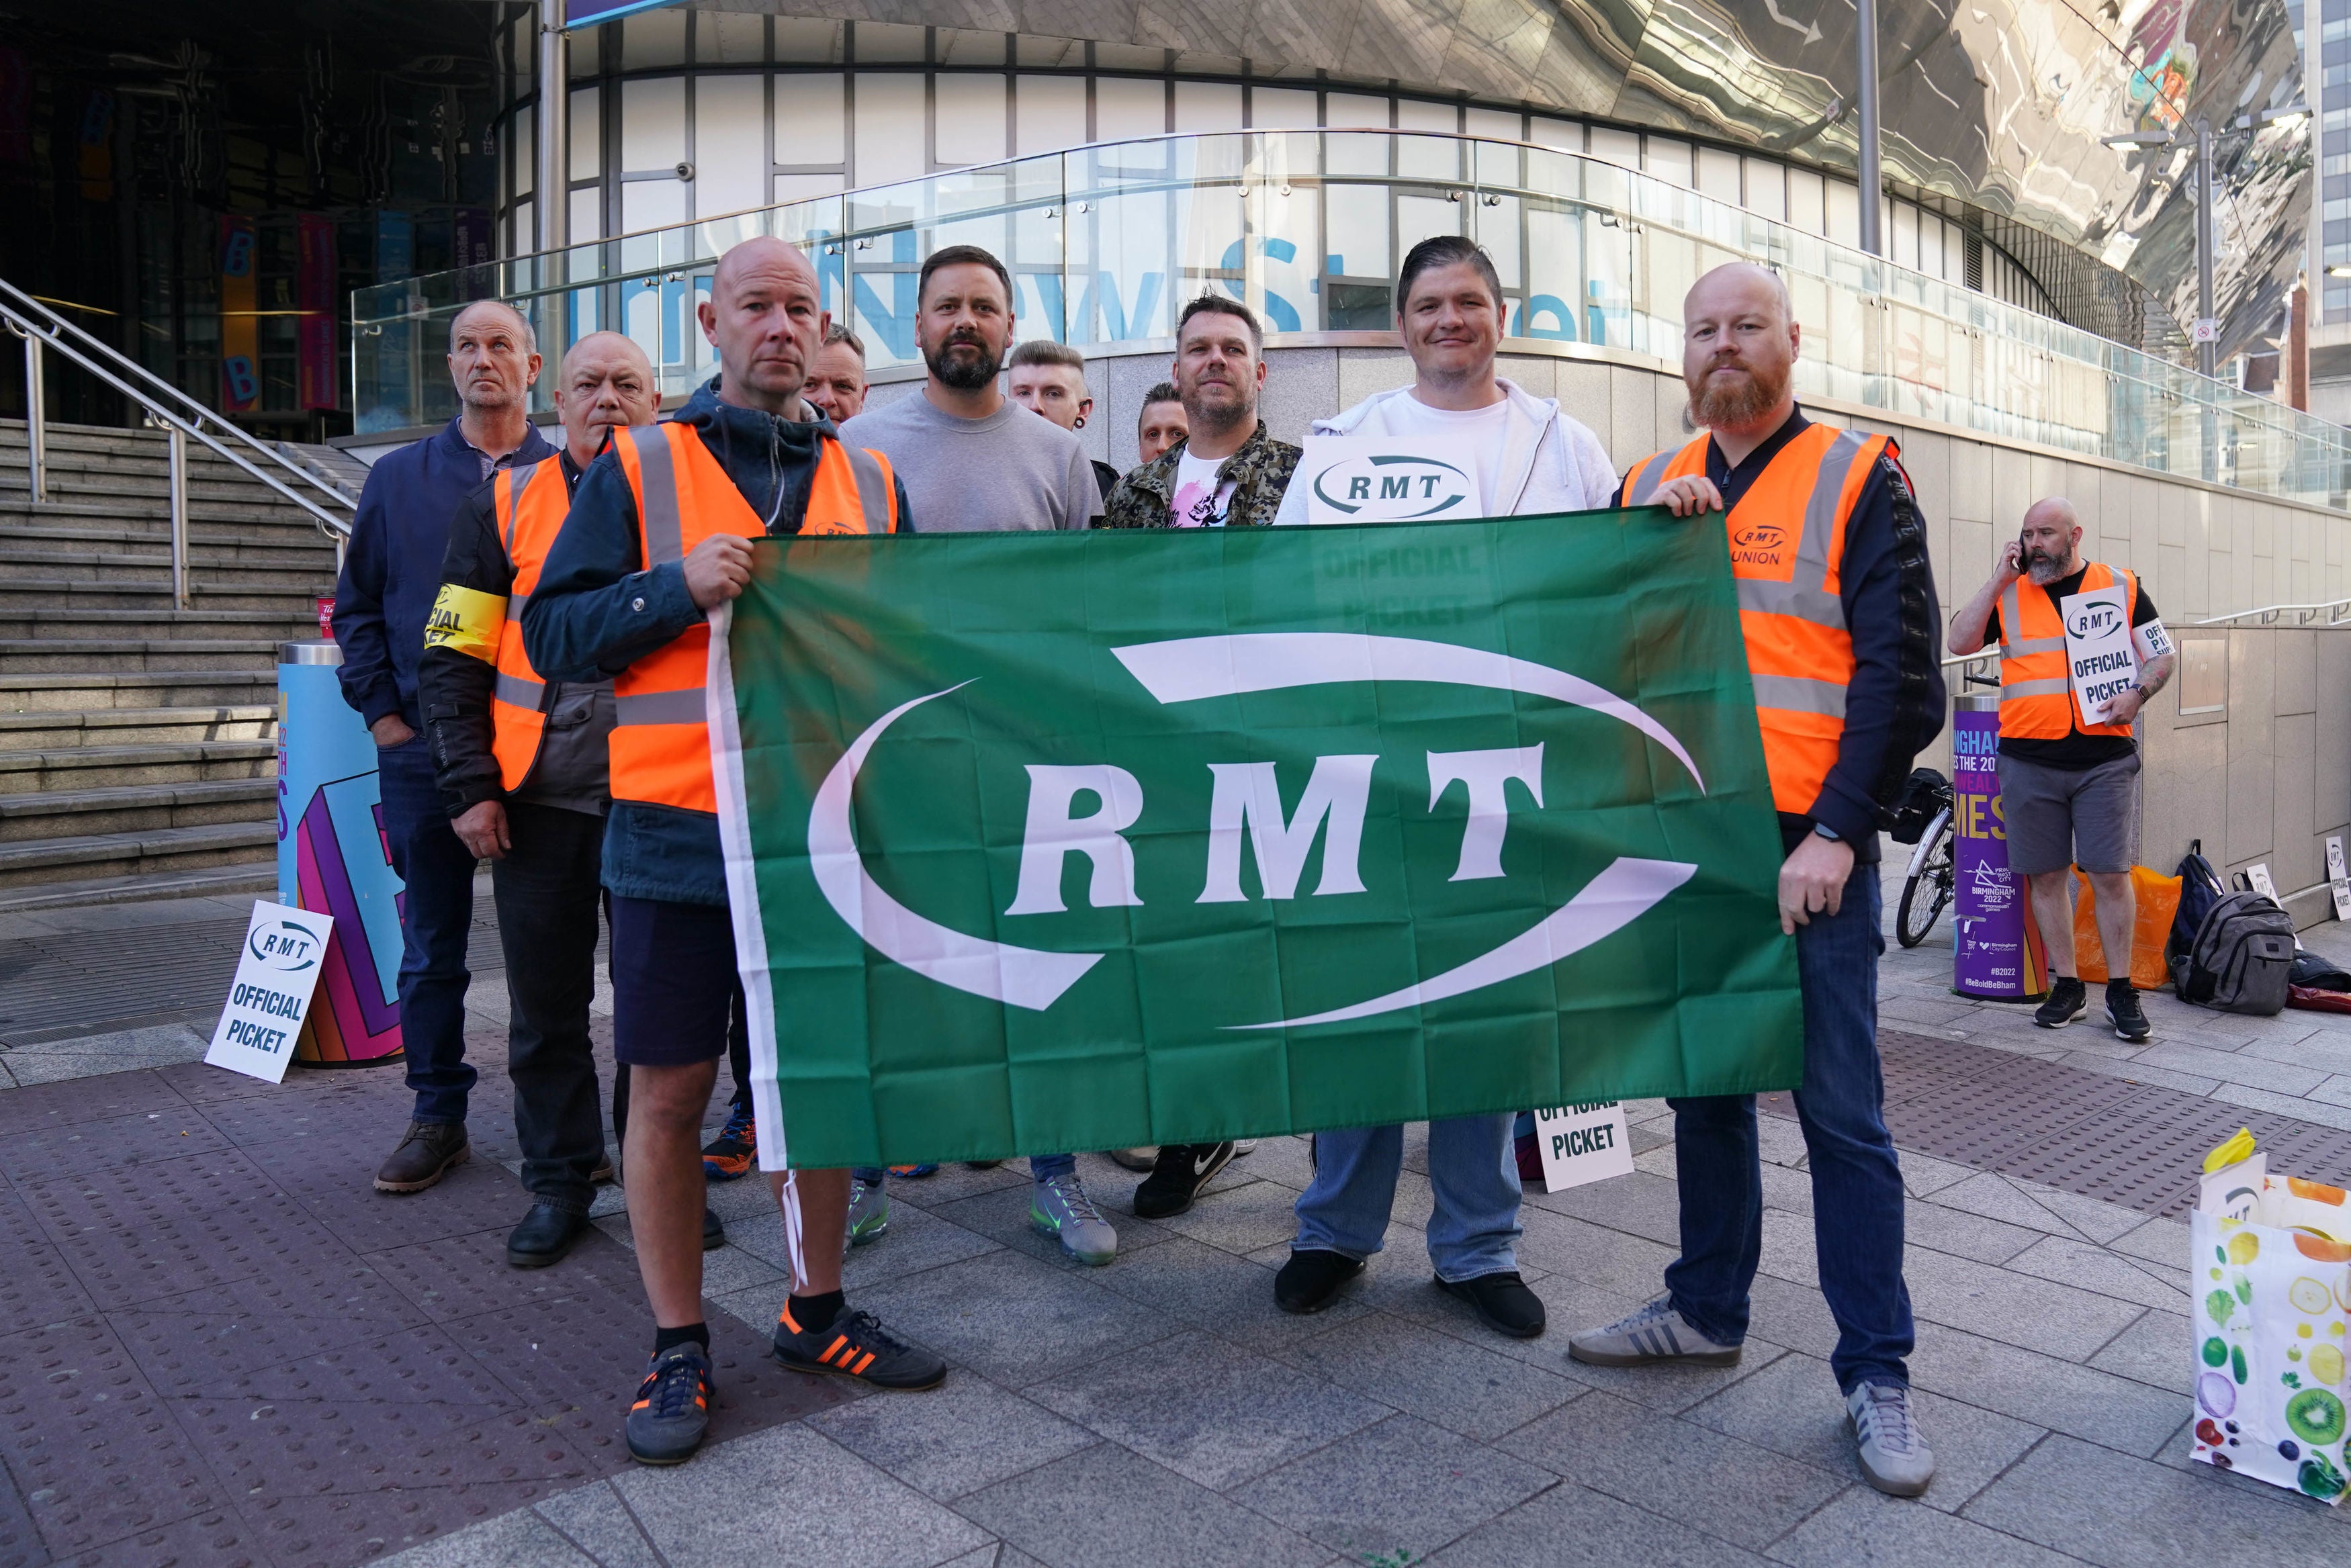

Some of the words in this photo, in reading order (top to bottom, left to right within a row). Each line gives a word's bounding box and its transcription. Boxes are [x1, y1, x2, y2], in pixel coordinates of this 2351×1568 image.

[806, 230, 1163, 359] Nw
[1347, 474, 1441, 500] RMT
[1743, 532, 1779, 543] RMT
[1731, 551, 1780, 565] UNION
[2079, 610, 2113, 632] RMT
[2074, 650, 2132, 678] OFFICIAL
[2086, 677, 2130, 704] PICKET
[1959, 756, 1977, 772] THE
[1003, 741, 1544, 916] RMT
[1971, 886, 2016, 896] BIRMINGHAM
[2332, 876, 2348, 891] OFFICIAL
[1984, 895, 2002, 903] 2022
[2336, 894, 2350, 908] PICKET
[262, 933, 310, 959] RMT
[1965, 977, 2016, 989] #BeBoldBeBham
[1991, 968, 2016, 976] #B2022
[232, 982, 302, 1021] OFFICIAL
[226, 1019, 287, 1054] PICKET
[1552, 1123, 1614, 1160] PICKET
